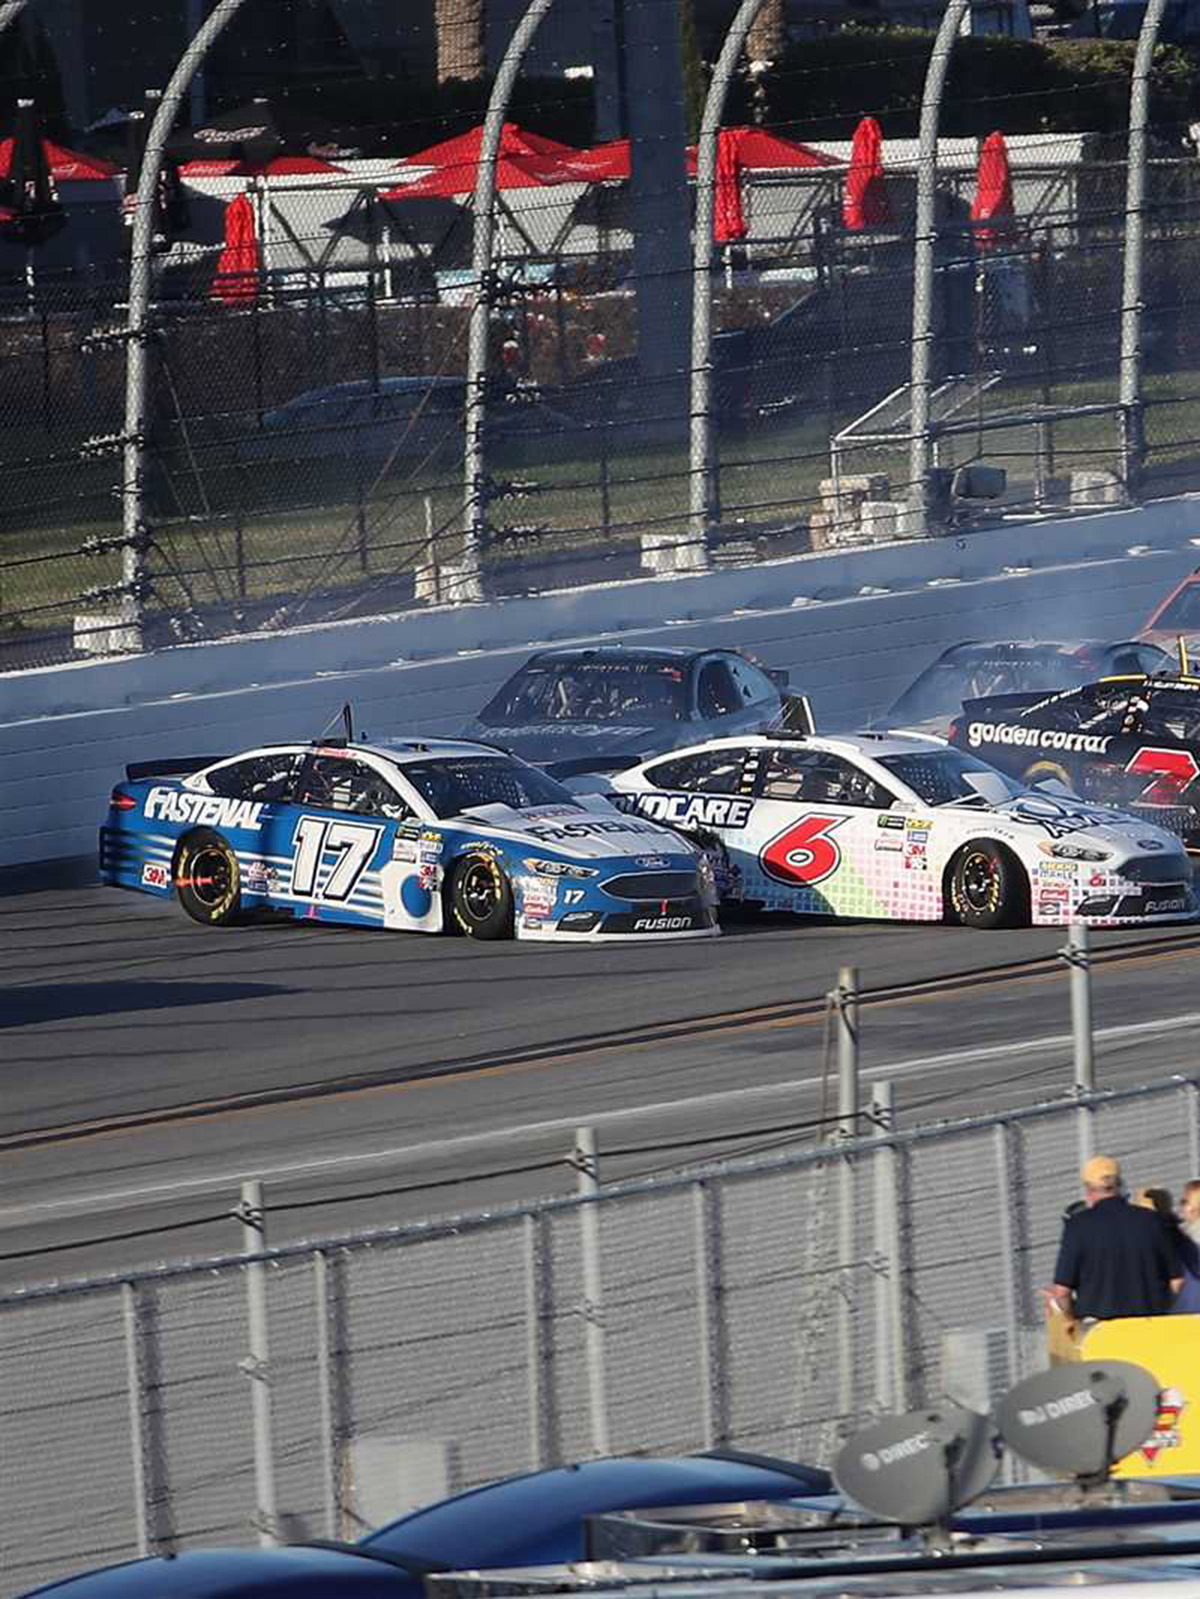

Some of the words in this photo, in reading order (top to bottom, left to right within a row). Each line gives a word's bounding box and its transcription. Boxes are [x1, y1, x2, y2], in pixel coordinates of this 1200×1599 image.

[143, 786, 264, 831] FASTENAL
[291, 815, 384, 903] 17
[758, 811, 854, 888] 6
[563, 888, 586, 904] 17
[634, 916, 692, 930] FUSION
